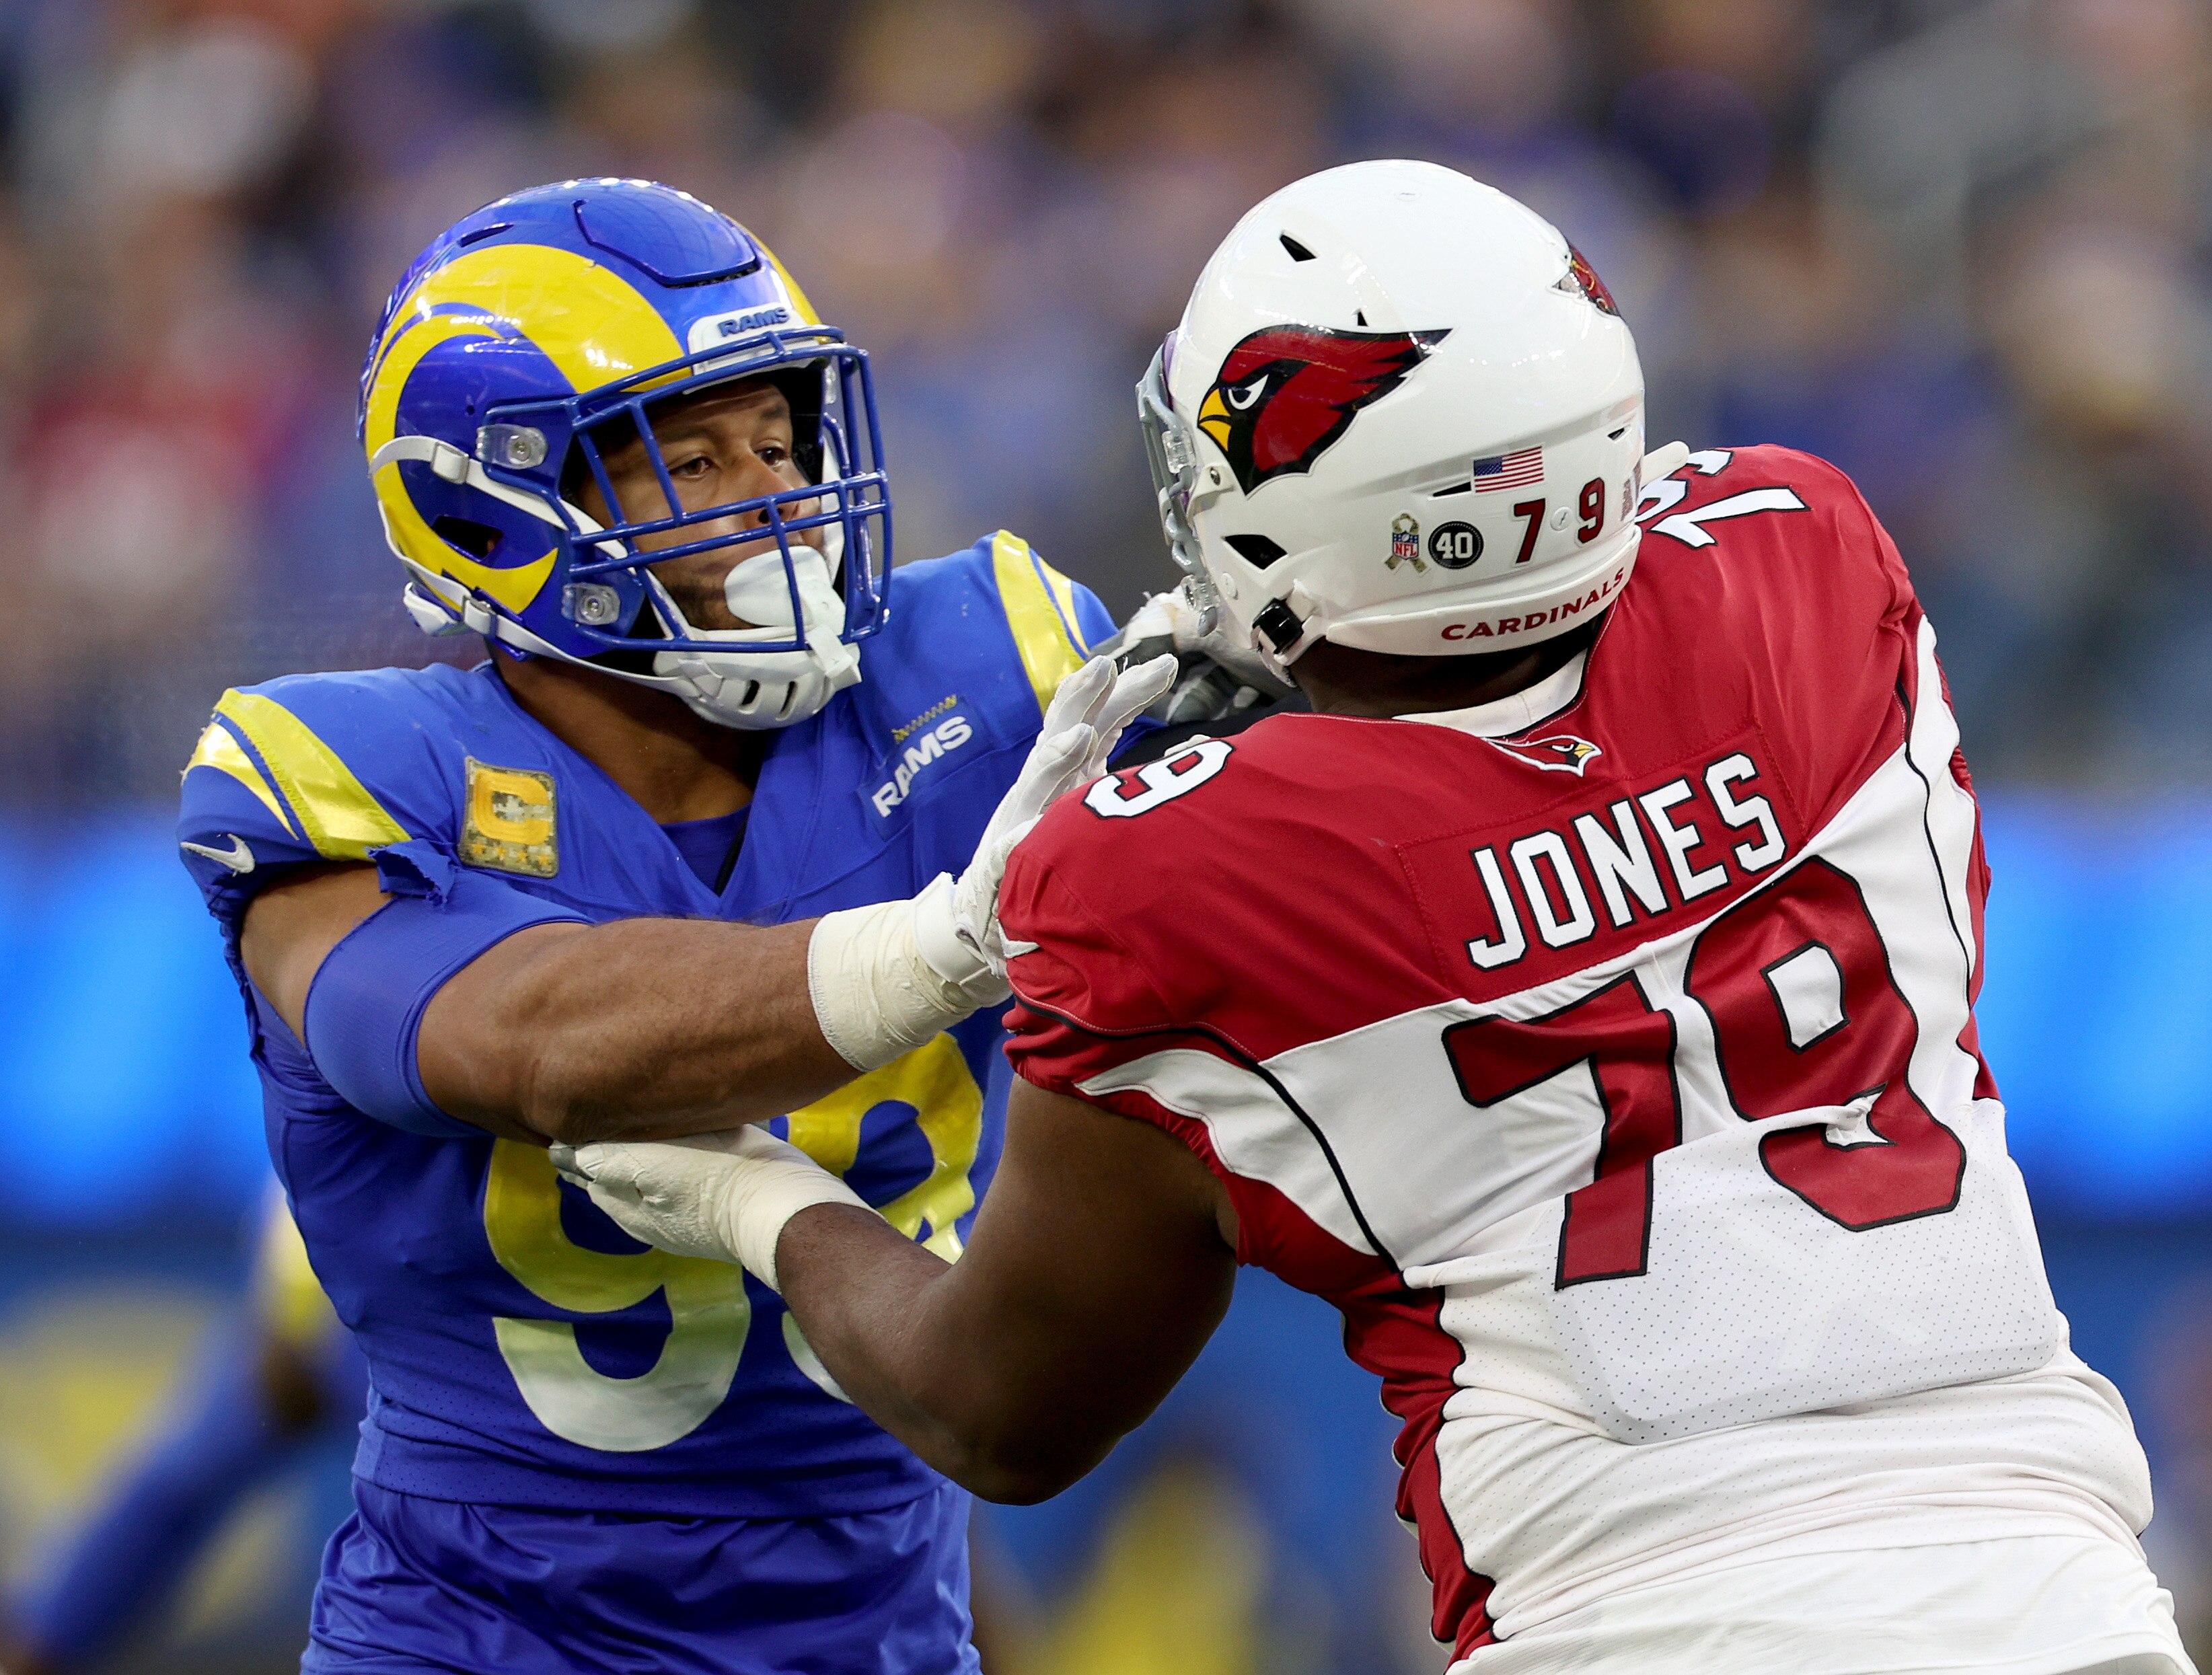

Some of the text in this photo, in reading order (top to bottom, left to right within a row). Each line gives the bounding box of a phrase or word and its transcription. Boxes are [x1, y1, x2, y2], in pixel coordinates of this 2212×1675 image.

[717, 307, 790, 337] RAMS
[1394, 542, 1417, 557] NFL
[1435, 531, 1473, 560] 40
[1441, 566, 1624, 641] CARDINALS
[871, 716, 973, 818] RAMS
[1467, 751, 1787, 973] JONES
[1441, 855, 1966, 1291] 79
